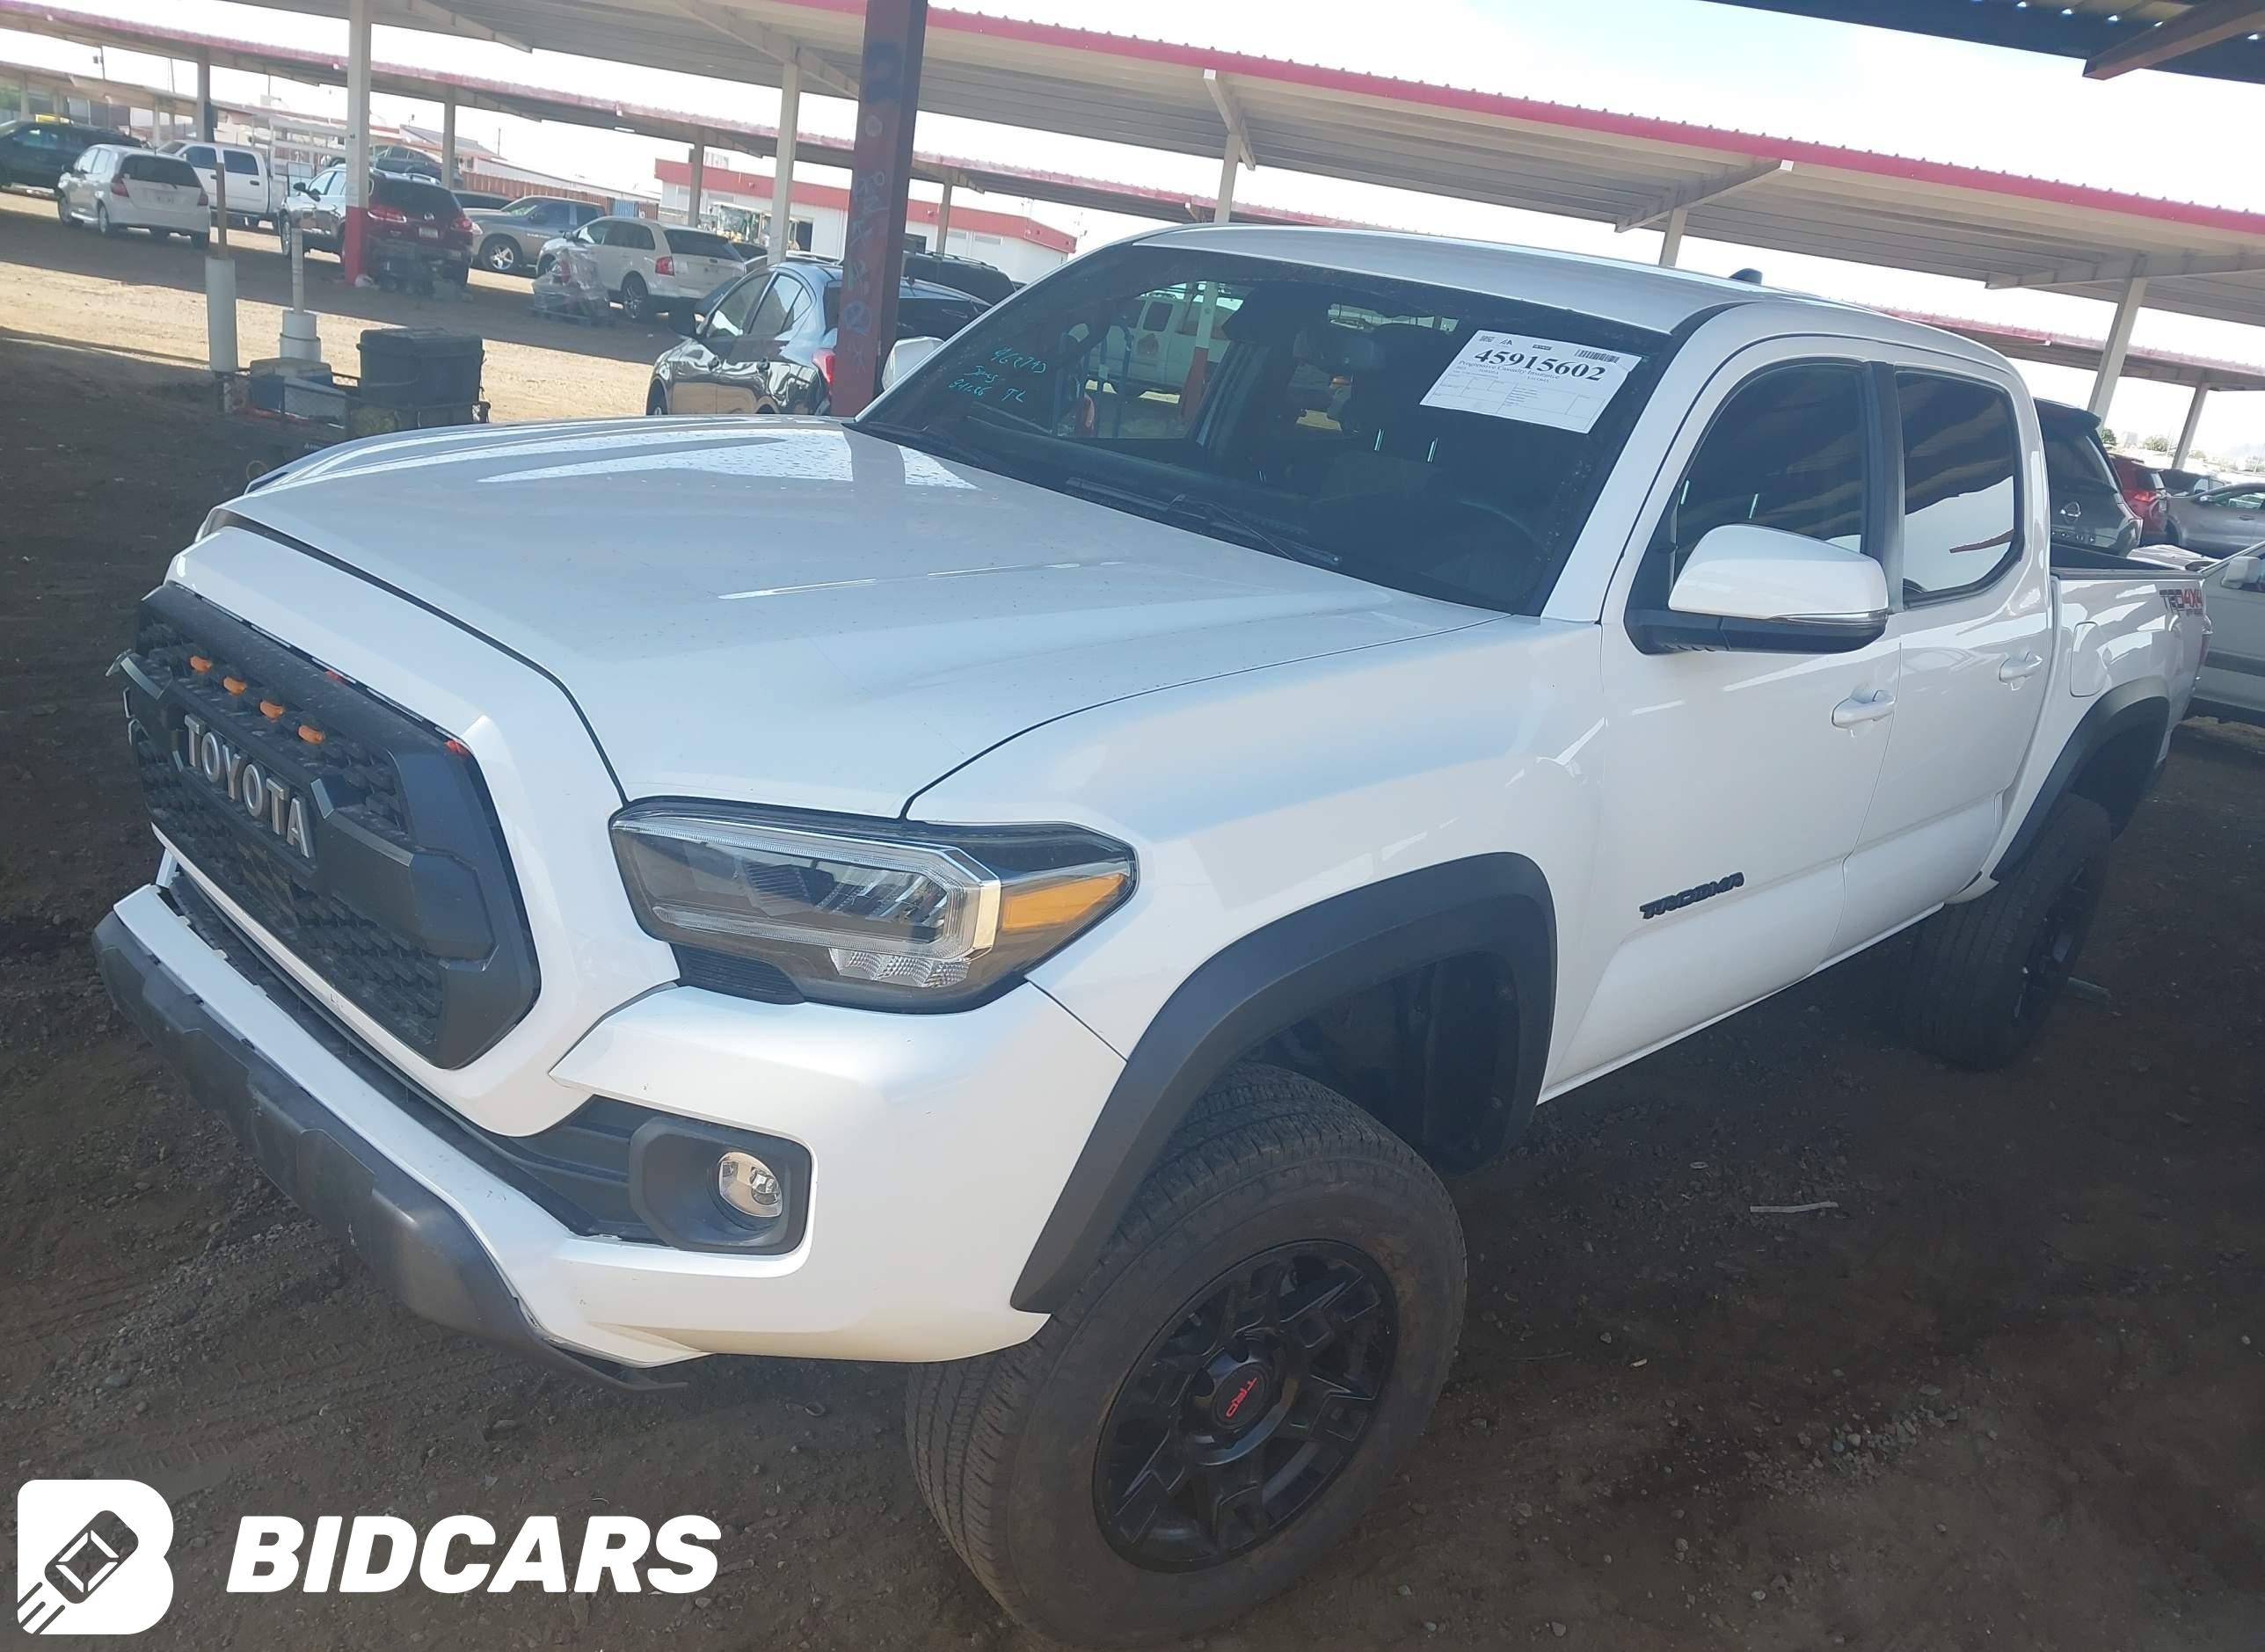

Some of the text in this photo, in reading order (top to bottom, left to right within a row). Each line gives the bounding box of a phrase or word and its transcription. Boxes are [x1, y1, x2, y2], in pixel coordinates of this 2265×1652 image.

[1458, 360, 1497, 370] Progressive
[1497, 366, 1526, 375] Casualty
[1527, 370, 1561, 380] Insurance
[1475, 349, 1606, 382] 45915602
[184, 714, 311, 859] TOYOTA
[1639, 871, 1745, 920] TACOMA
[1225, 1377, 1258, 1418] TRD
